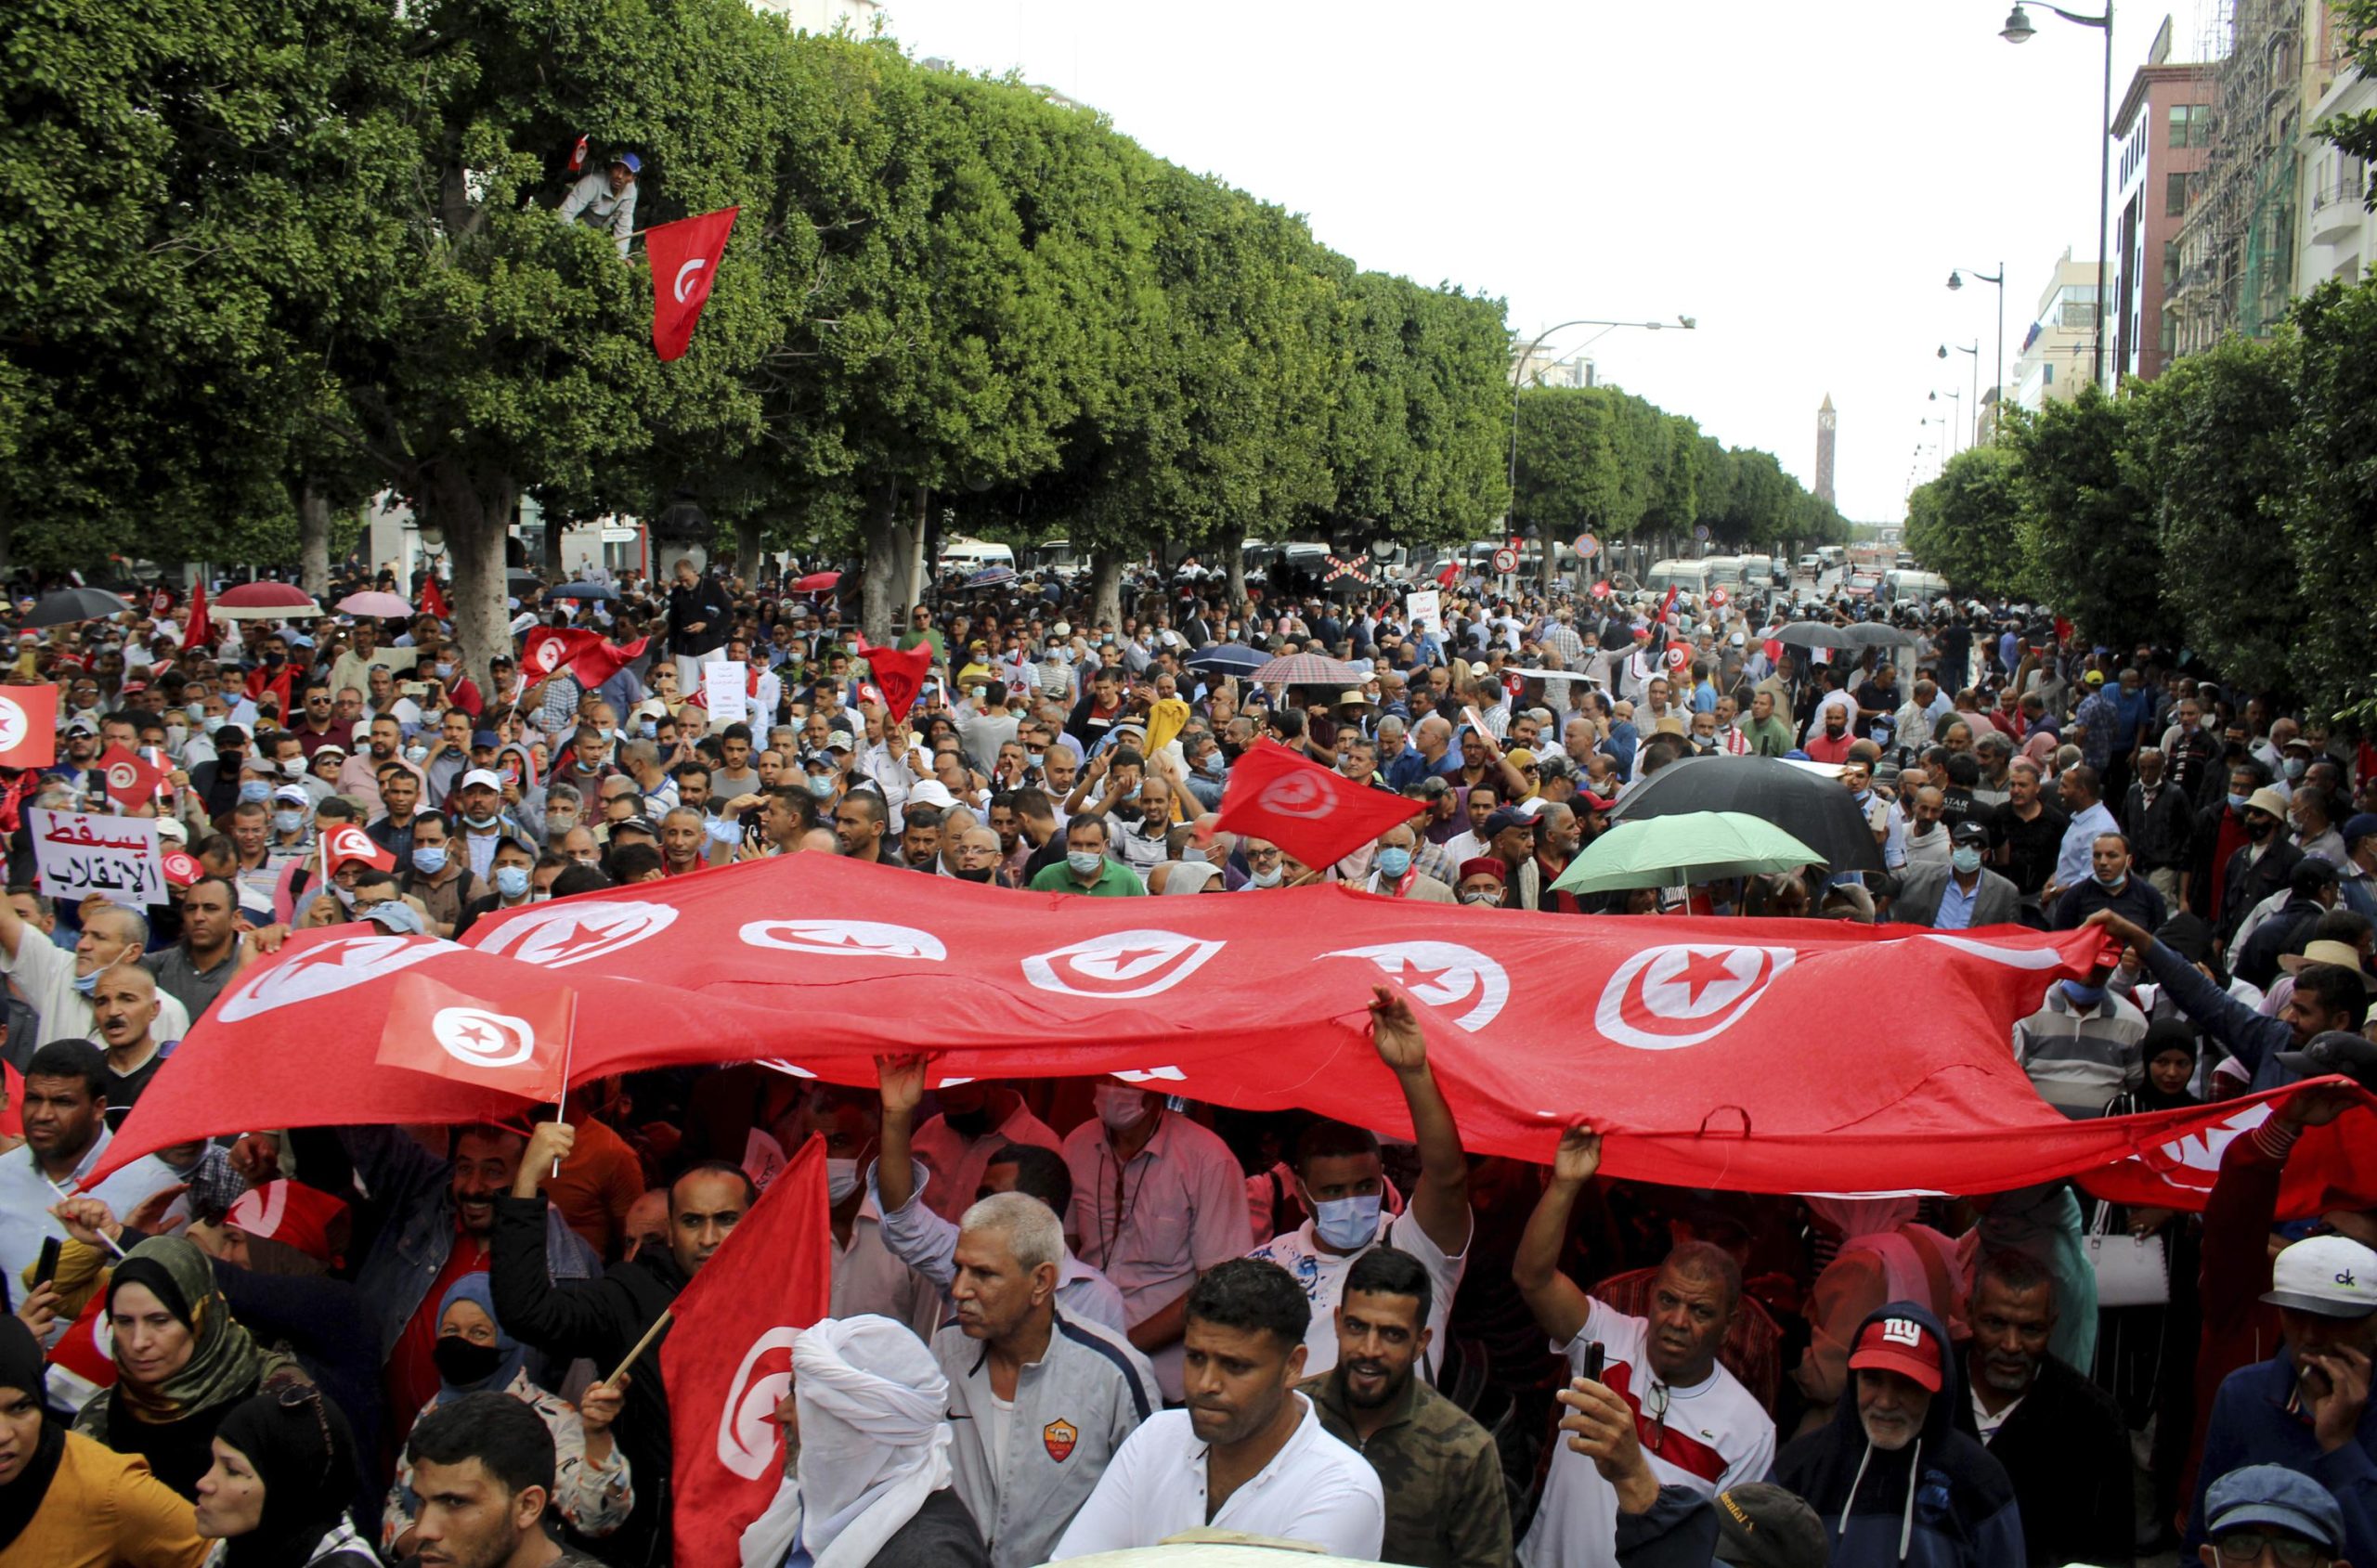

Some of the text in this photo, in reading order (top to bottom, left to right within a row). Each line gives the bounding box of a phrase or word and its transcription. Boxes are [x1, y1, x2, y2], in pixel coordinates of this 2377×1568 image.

[45, 811, 149, 859] يسقط
[46, 856, 157, 901] الإنقلاب
[2335, 1268, 2355, 1287] ck
